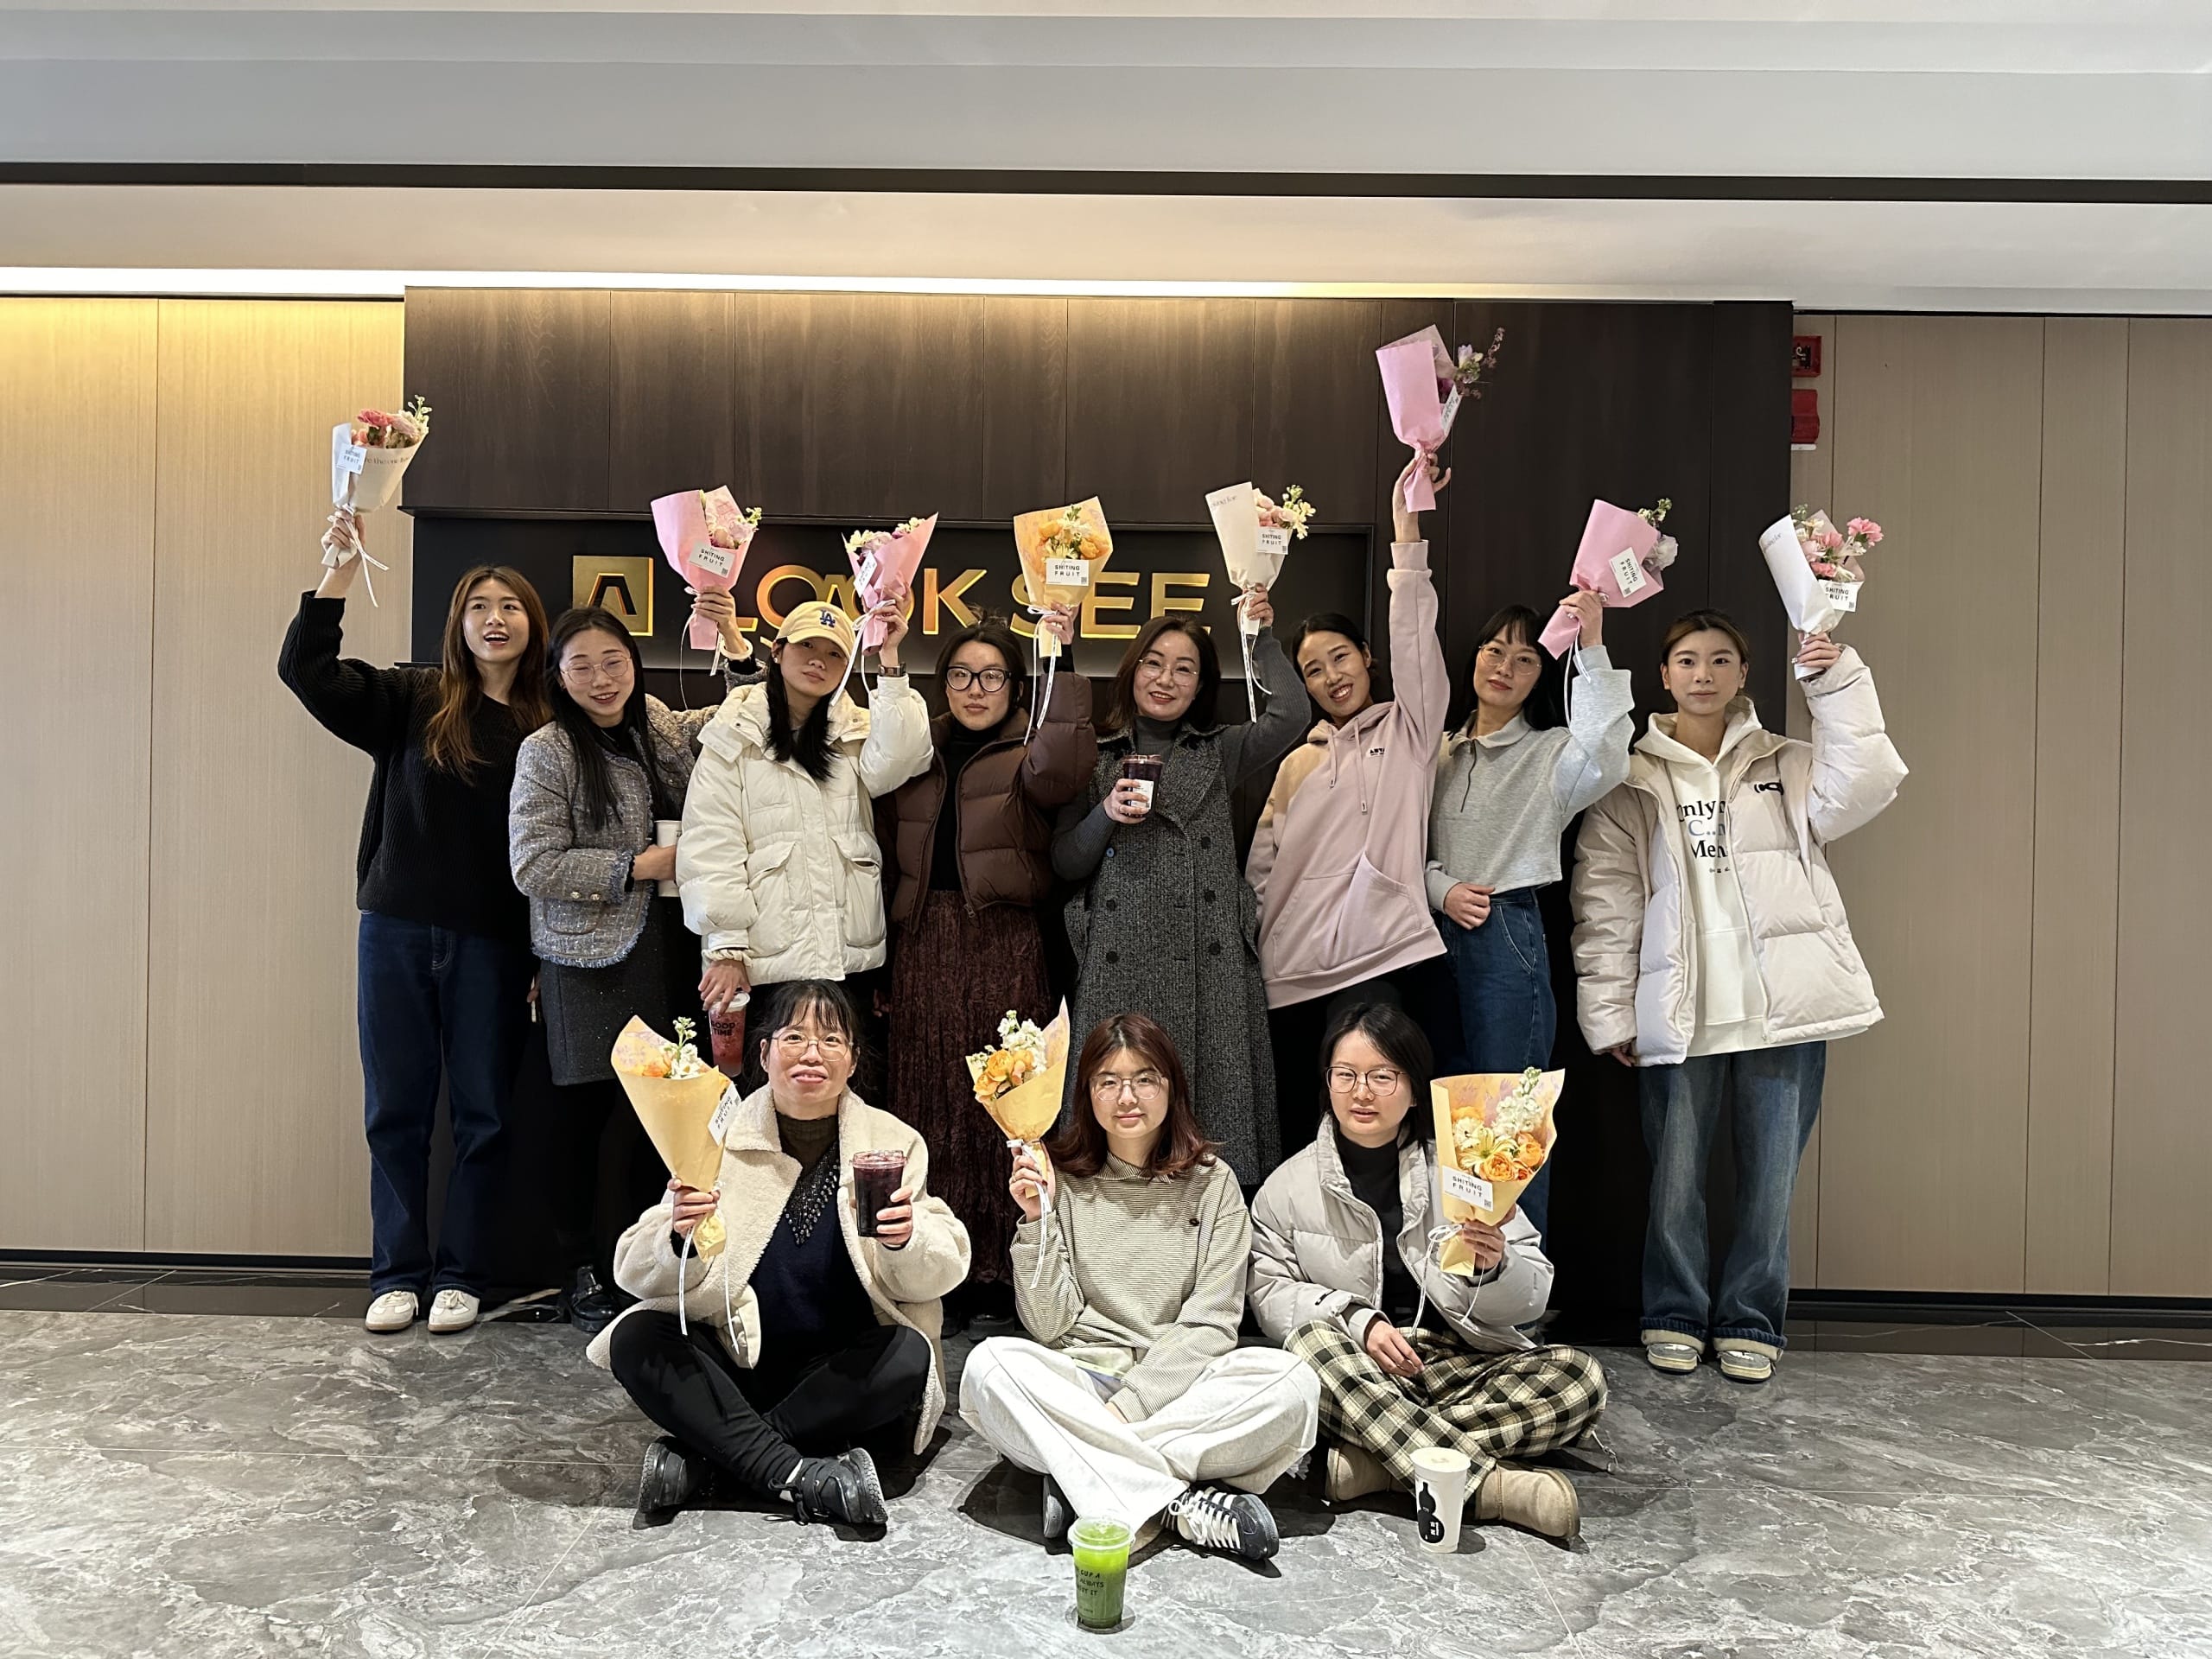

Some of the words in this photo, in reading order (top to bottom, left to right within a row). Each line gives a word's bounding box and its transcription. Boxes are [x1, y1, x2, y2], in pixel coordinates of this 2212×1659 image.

[698, 554, 723, 567] FRUIT
[701, 548, 725, 562] SHITING
[1620, 561, 1633, 585] FRUIT
[1625, 558, 1638, 582] SHITING
[1825, 587, 1849, 595] SHITING
[1452, 1175, 1483, 1192] SHITING
[1452, 1182, 1483, 1198] FRUIT
